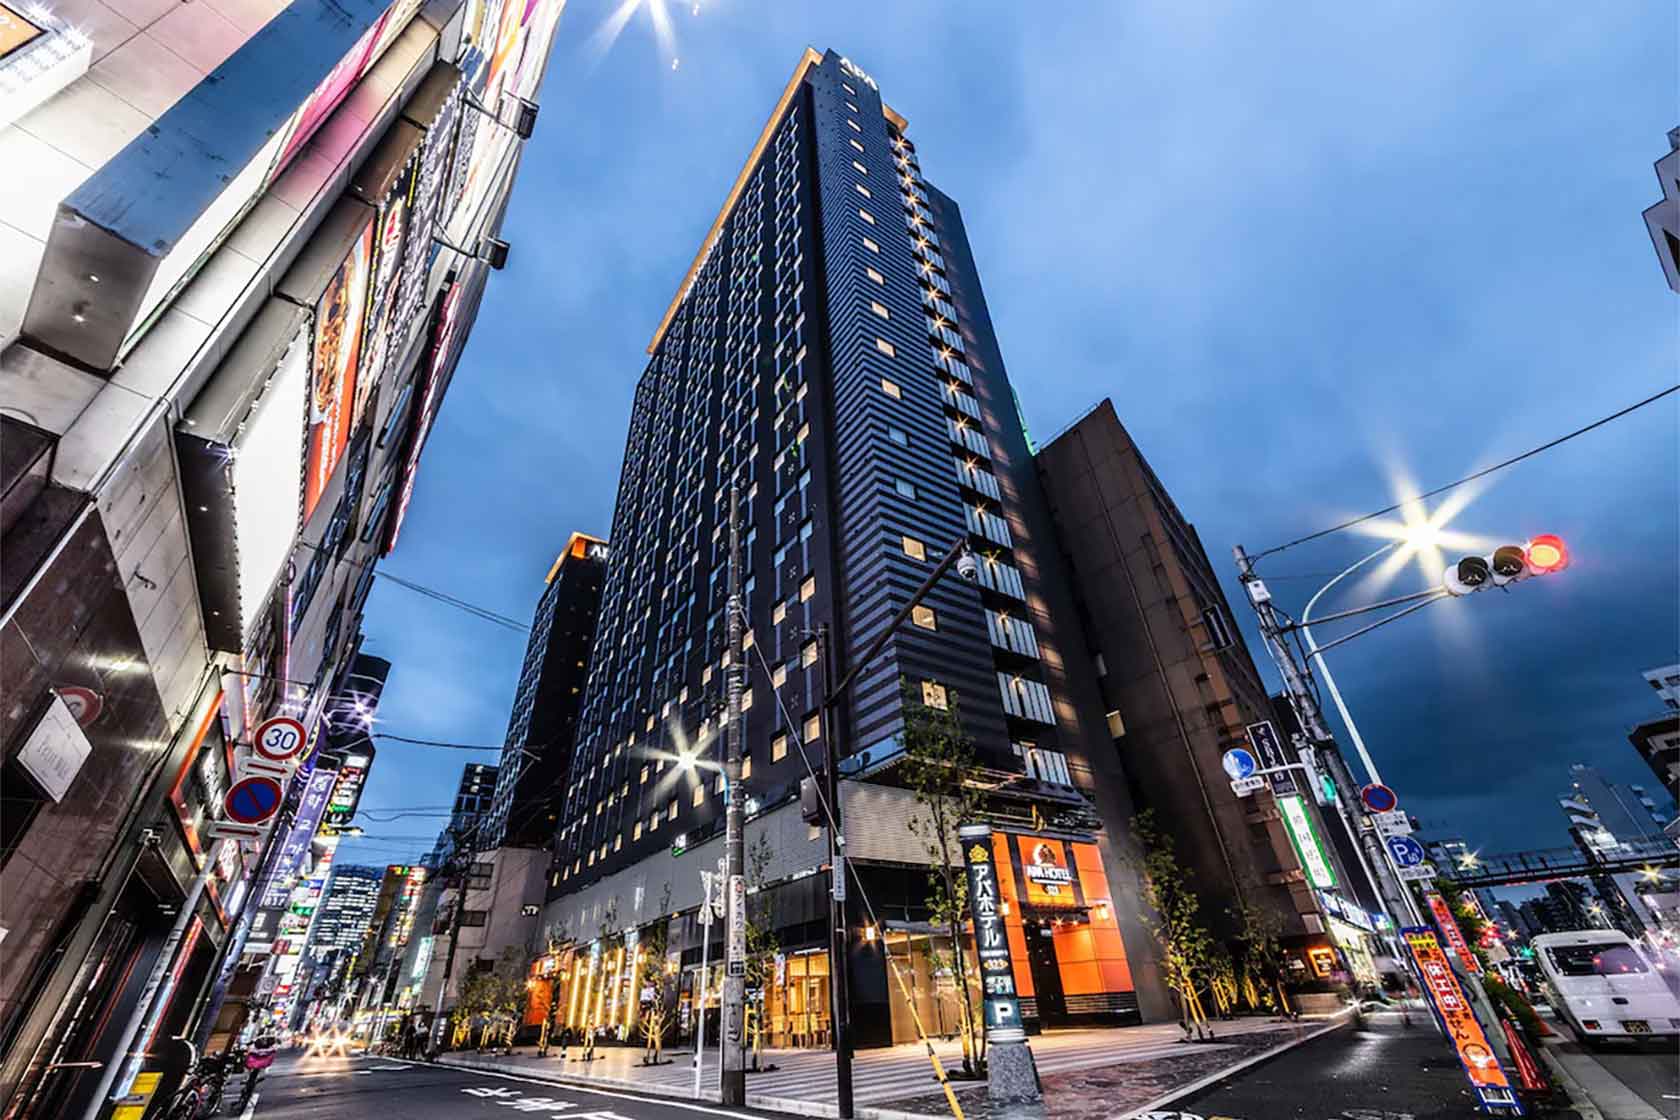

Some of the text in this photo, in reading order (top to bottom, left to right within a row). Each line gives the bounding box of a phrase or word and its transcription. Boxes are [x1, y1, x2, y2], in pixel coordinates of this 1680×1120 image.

[266, 728, 296, 750] 30
[1392, 844, 1409, 864] P
[994, 1002, 1013, 1025] P
